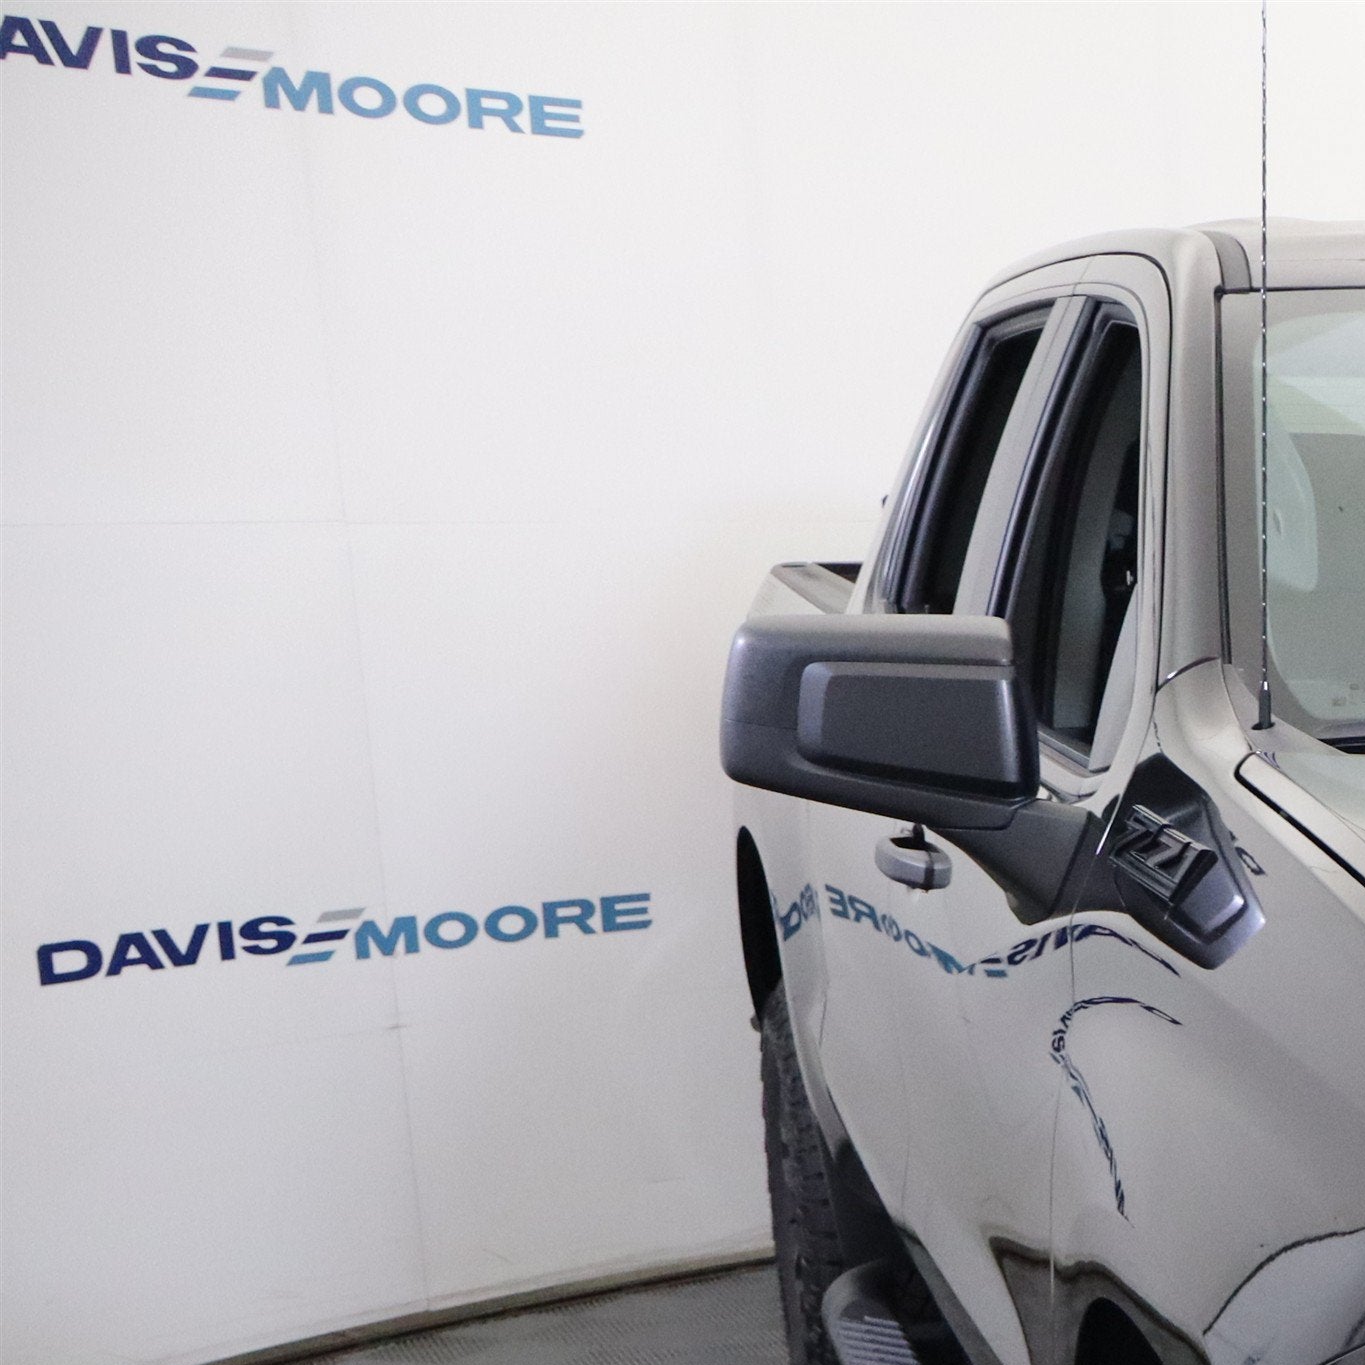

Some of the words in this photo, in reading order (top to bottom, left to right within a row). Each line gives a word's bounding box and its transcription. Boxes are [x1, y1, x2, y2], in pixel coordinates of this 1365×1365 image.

[262, 66, 585, 138] MOORE
[37, 914, 298, 985] DAVIS
[353, 892, 653, 961] MOORE
